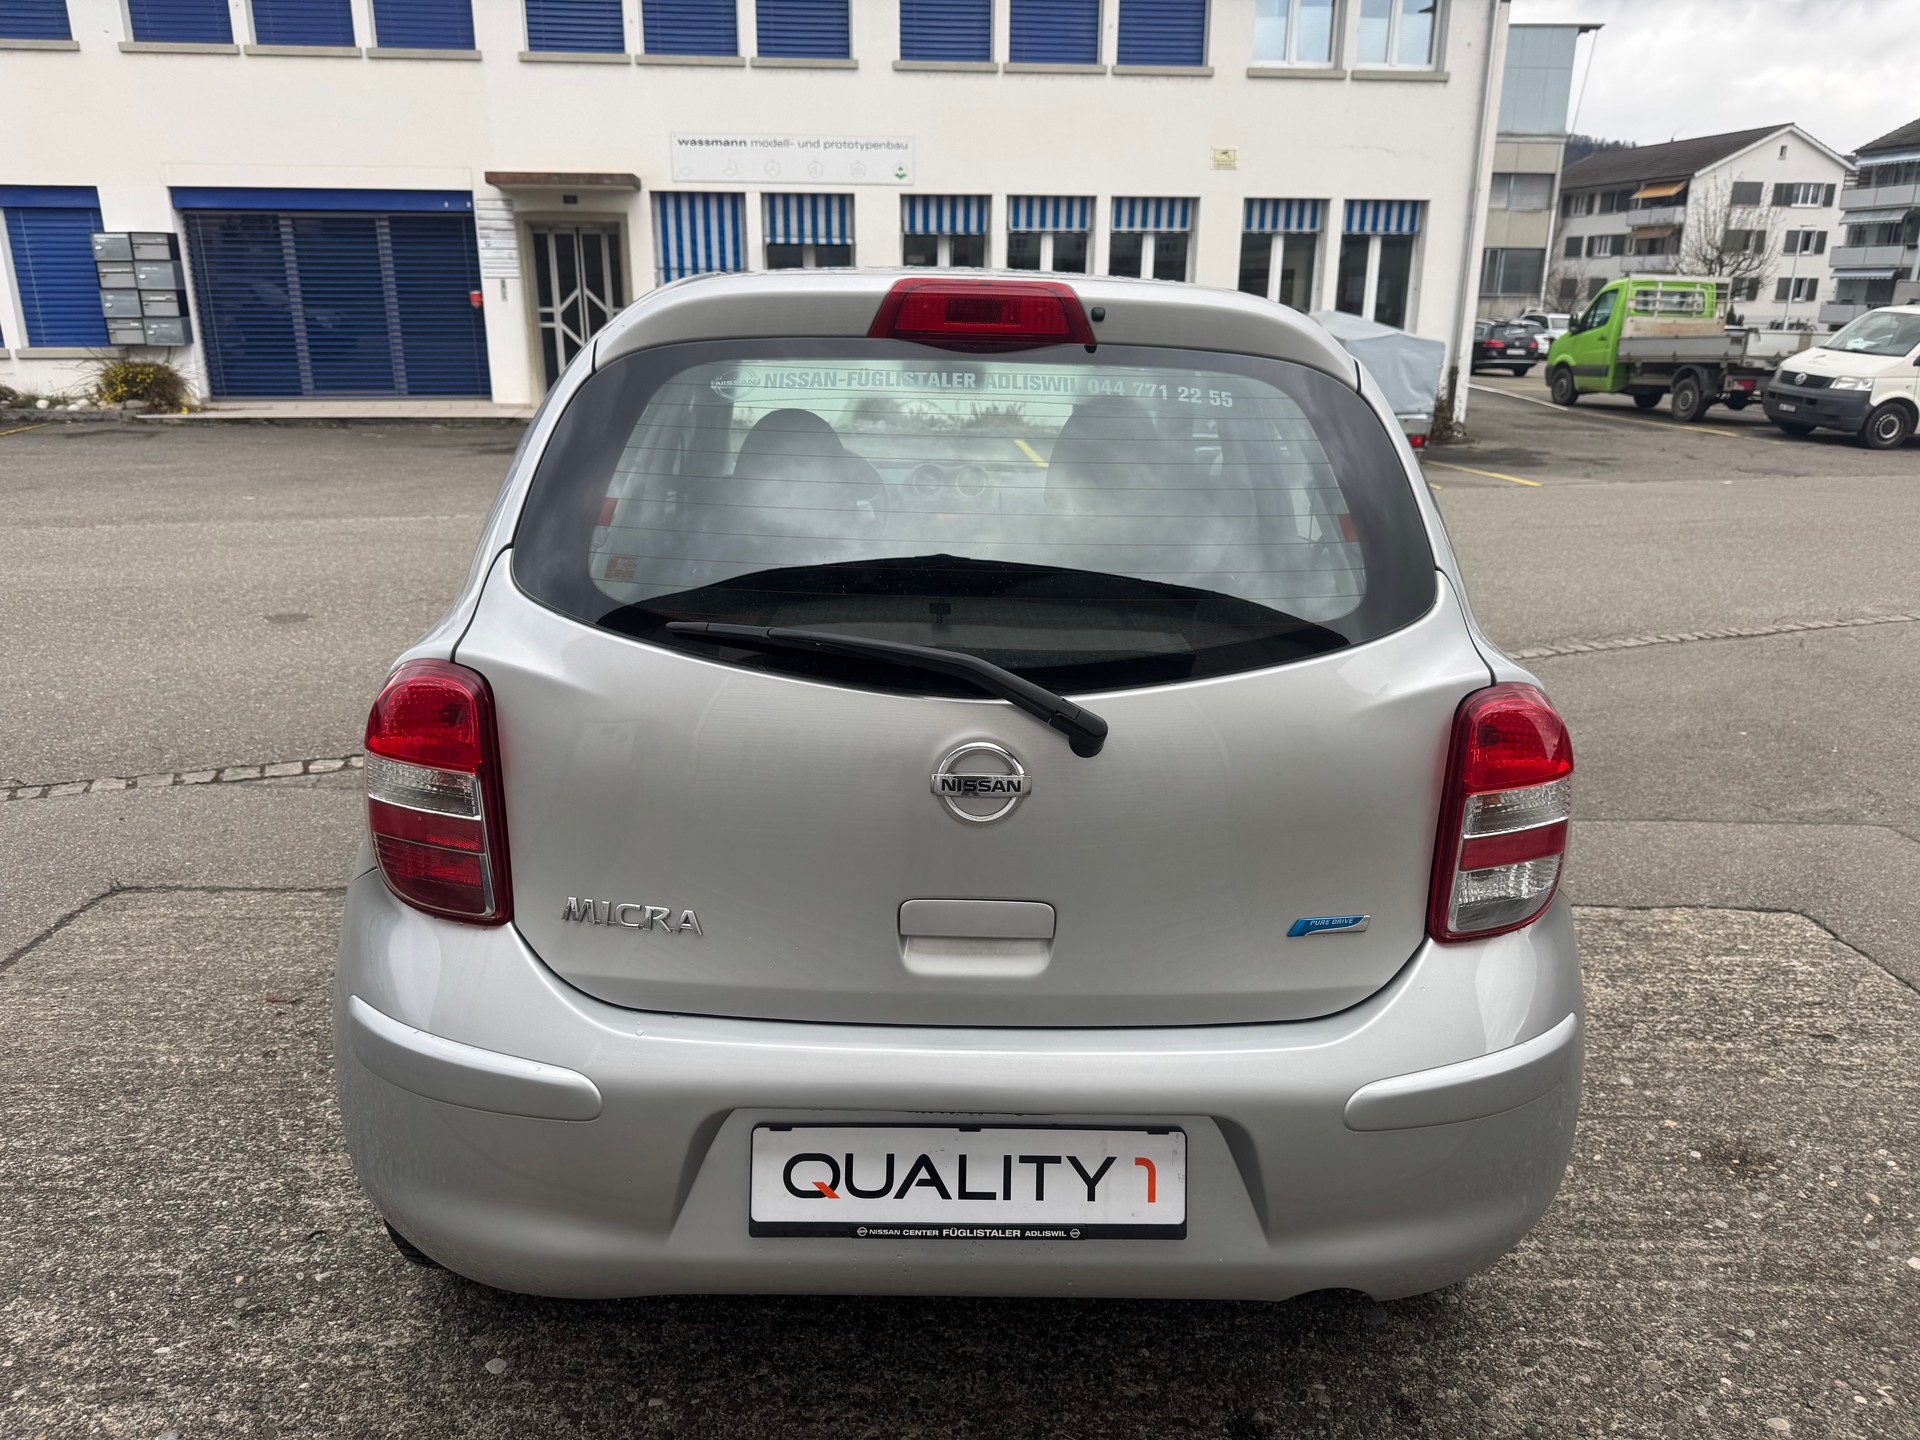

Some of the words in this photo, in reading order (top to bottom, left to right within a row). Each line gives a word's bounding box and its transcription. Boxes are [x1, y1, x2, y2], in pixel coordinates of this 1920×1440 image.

[677, 137, 748, 148] wassmann
[750, 138, 795, 149] modell-
[797, 140, 821, 150] und
[823, 140, 909, 152] prototypenbau
[715, 379, 757, 387] NISAN
[764, 368, 976, 390] NISSAN-FÜGLISTALER
[1088, 378, 1126, 396] 044
[1132, 381, 1168, 400] 771
[1177, 386, 1203, 404] 22
[1208, 389, 1233, 408] 55
[941, 778, 1022, 793] NISSAN
[561, 896, 703, 936] MICRA
[1331, 917, 1354, 925] DRIVE
[782, 1152, 1118, 1203] QUALITY
[1134, 1156, 1157, 1204] 1
[869, 1228, 900, 1236] NISSAN
[942, 1227, 1021, 1238] FÜGLISTALER
